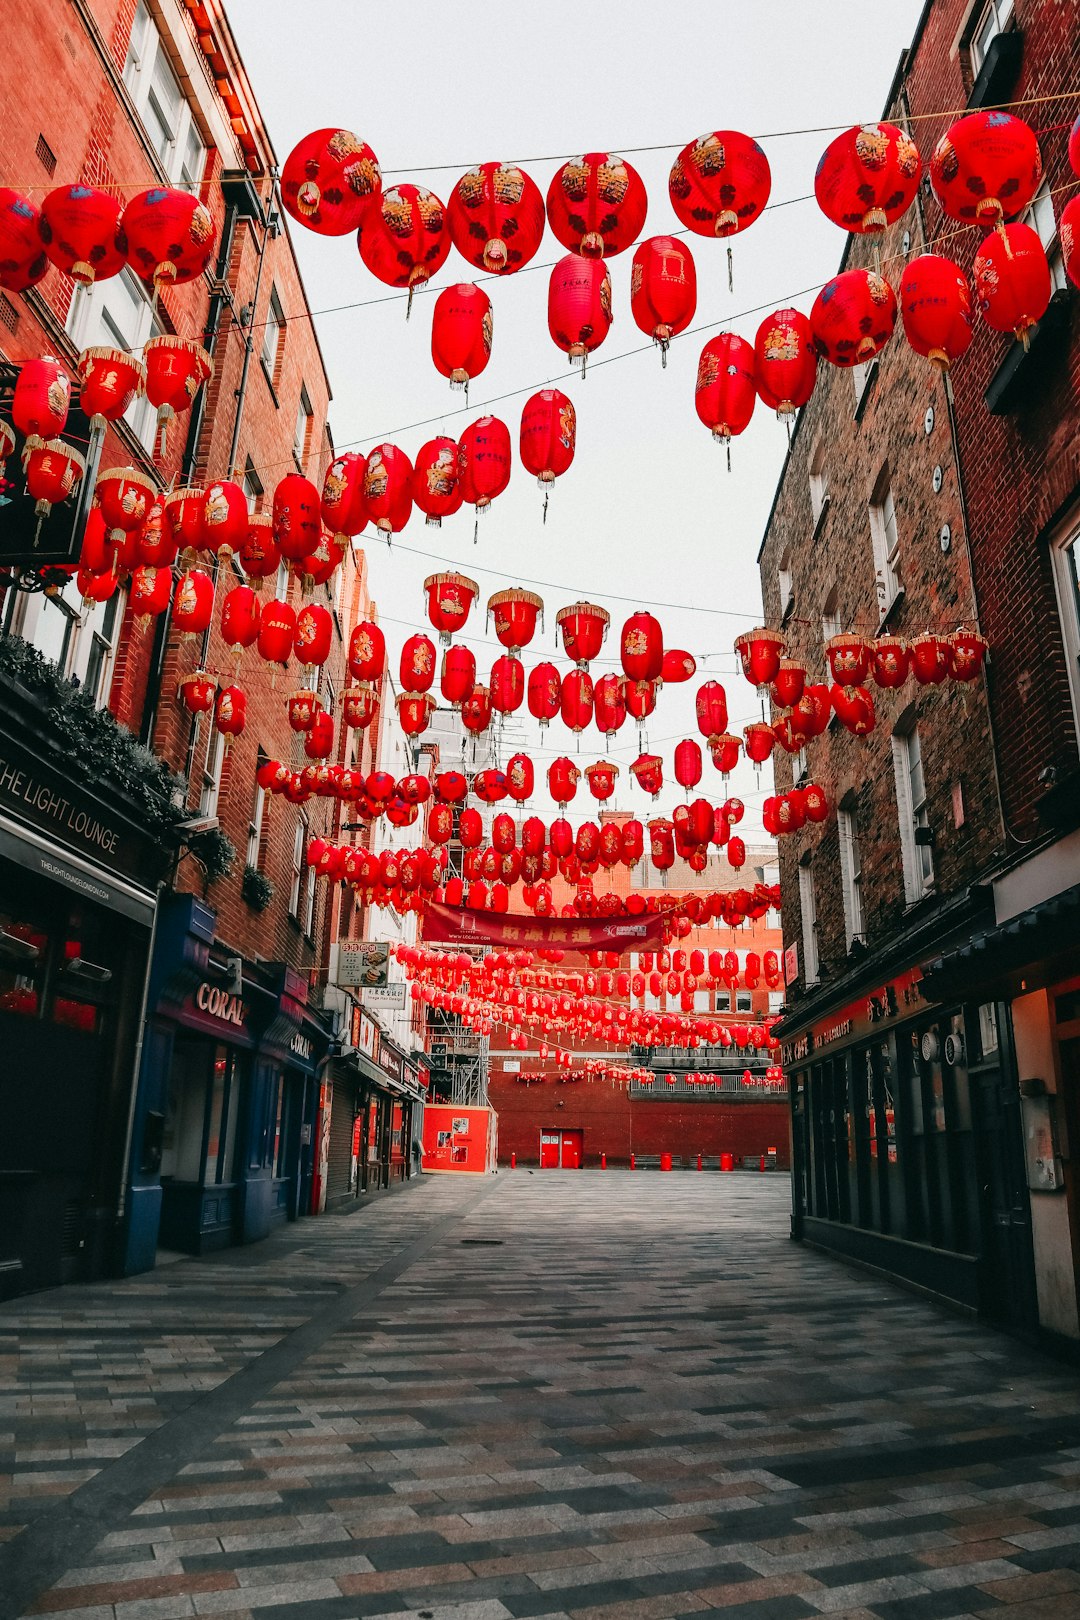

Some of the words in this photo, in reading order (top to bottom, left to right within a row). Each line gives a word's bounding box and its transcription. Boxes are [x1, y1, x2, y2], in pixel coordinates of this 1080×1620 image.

[24, 779, 70, 821] LIGHT
[67, 807, 120, 854] LOUNGE
[40, 859, 109, 901] THELIGHTLOUNGELONDON.COM
[197, 983, 243, 1026] CORAL
[290, 1033, 310, 1060] CORAL
